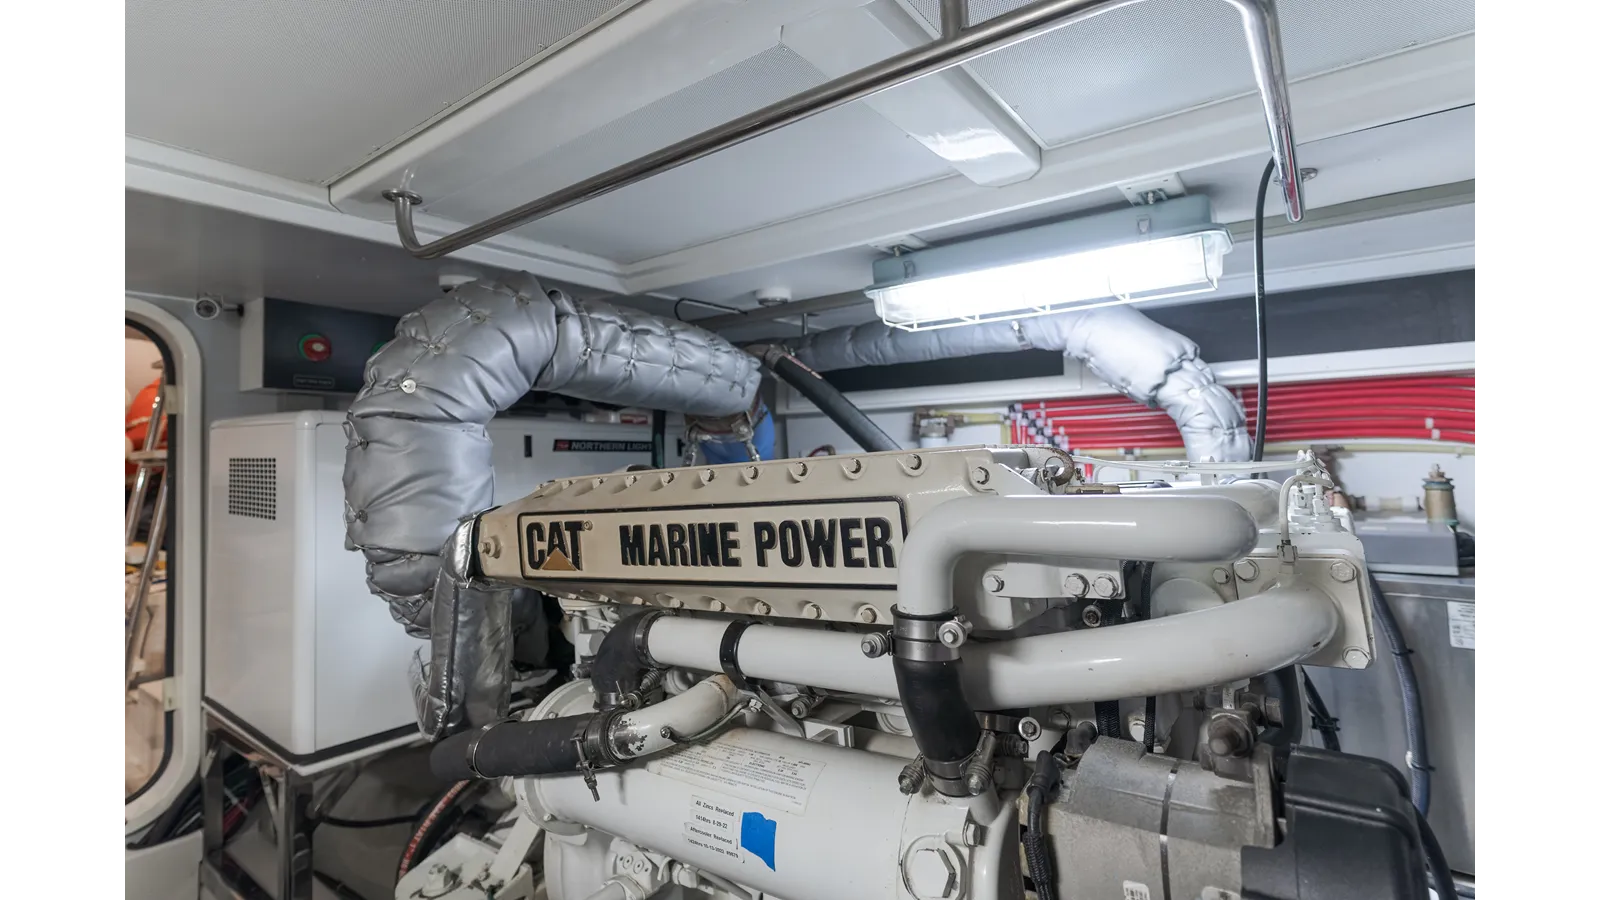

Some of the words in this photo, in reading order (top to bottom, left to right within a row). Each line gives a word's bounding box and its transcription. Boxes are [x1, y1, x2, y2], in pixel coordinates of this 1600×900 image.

[571, 441, 625, 450] NORTHERN
[619, 521, 742, 568] MARINE
[753, 517, 897, 569] POWER
[703, 802, 713, 811] Zincs
[715, 807, 734, 817] Replaced
[690, 827, 711, 837] Aftercooler
[714, 833, 732, 844] Replaced
